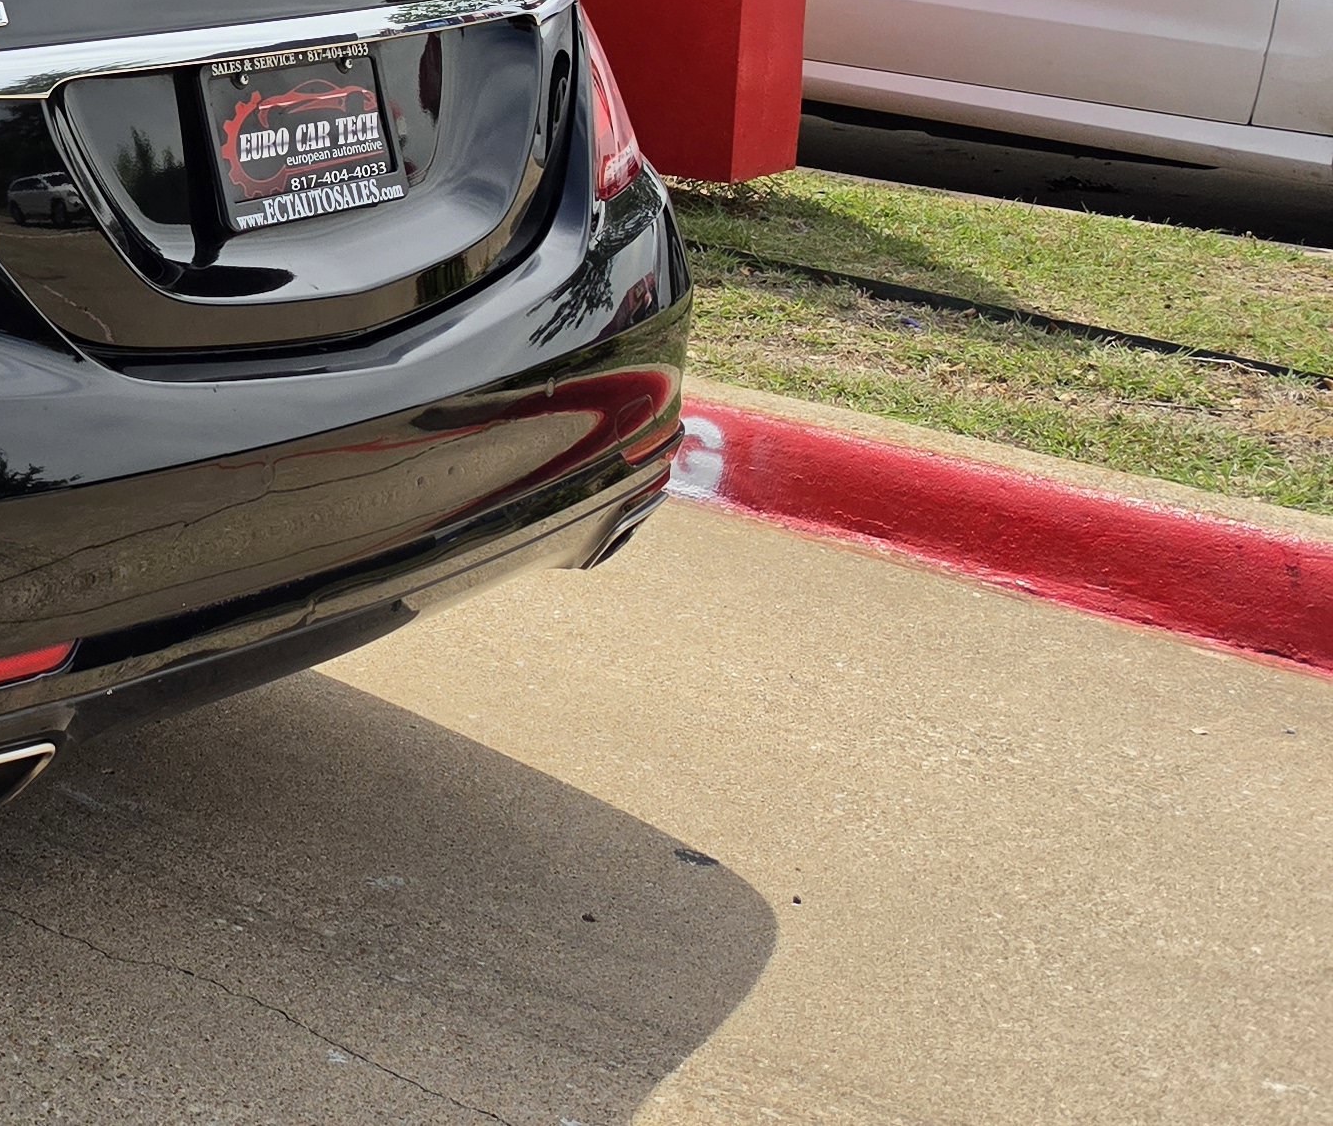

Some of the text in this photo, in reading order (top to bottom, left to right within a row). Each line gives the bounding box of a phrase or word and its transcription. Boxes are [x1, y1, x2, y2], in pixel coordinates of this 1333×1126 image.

[211, 43, 369, 76] SALES & SERVICE 817-404-4033
[239, 112, 380, 162] EURO CAR TECH
[286, 140, 383, 166] european automotive
[290, 161, 387, 191] 817-404-4033
[236, 178, 404, 230] www.ECTAUTOSALES.com
